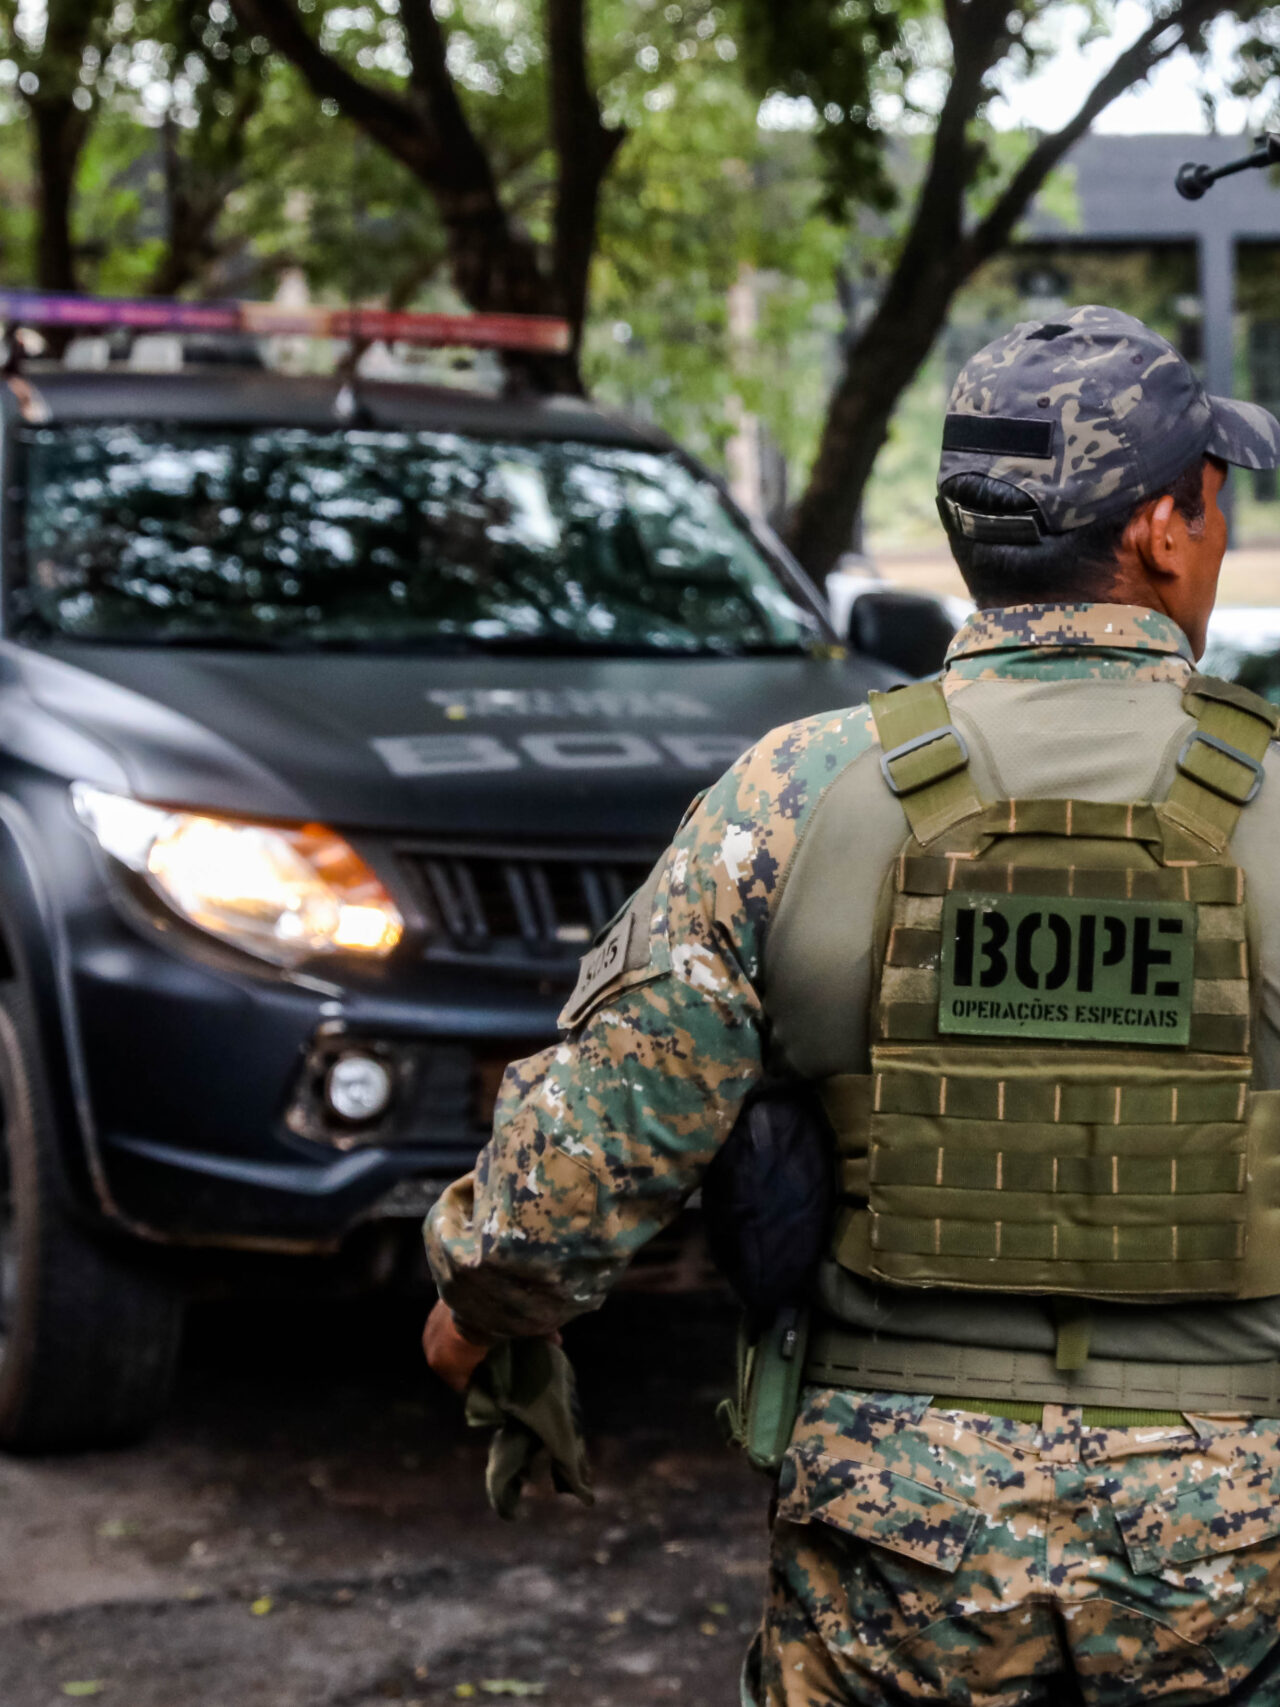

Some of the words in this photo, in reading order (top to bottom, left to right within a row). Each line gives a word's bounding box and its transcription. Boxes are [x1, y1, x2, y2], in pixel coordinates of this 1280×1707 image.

[368, 732, 757, 777] BOP
[953, 908, 1183, 997] BOPE
[951, 998, 1069, 1027] OPERAÇÕES
[1075, 1004, 1179, 1029] ESPECIAIS
